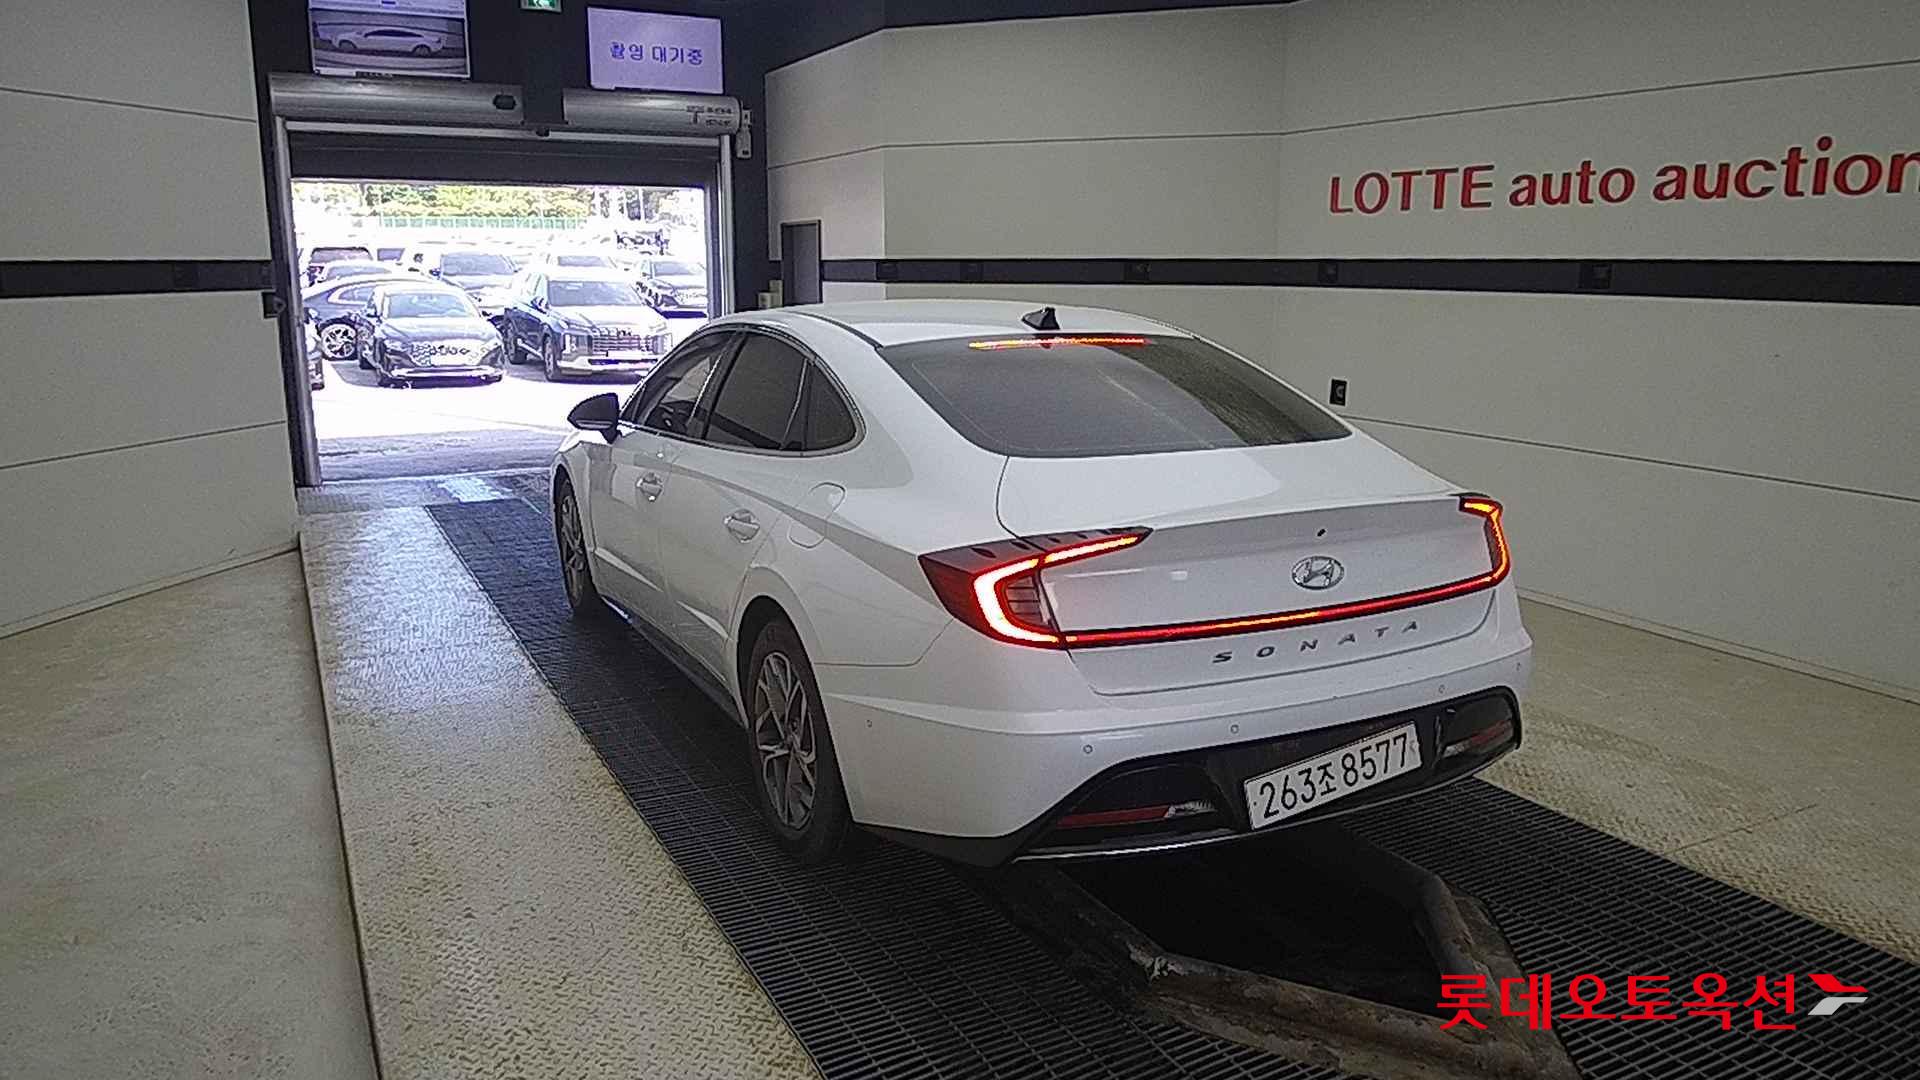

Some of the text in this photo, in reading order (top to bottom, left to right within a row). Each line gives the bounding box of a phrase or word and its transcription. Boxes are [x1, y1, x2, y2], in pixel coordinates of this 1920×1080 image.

[610, 41, 703, 66] 촬영 대기중
[1329, 135, 1920, 214] LOTTE auto auction
[1212, 620, 1418, 664] SONATA
[1259, 732, 1408, 819] 263조8577
